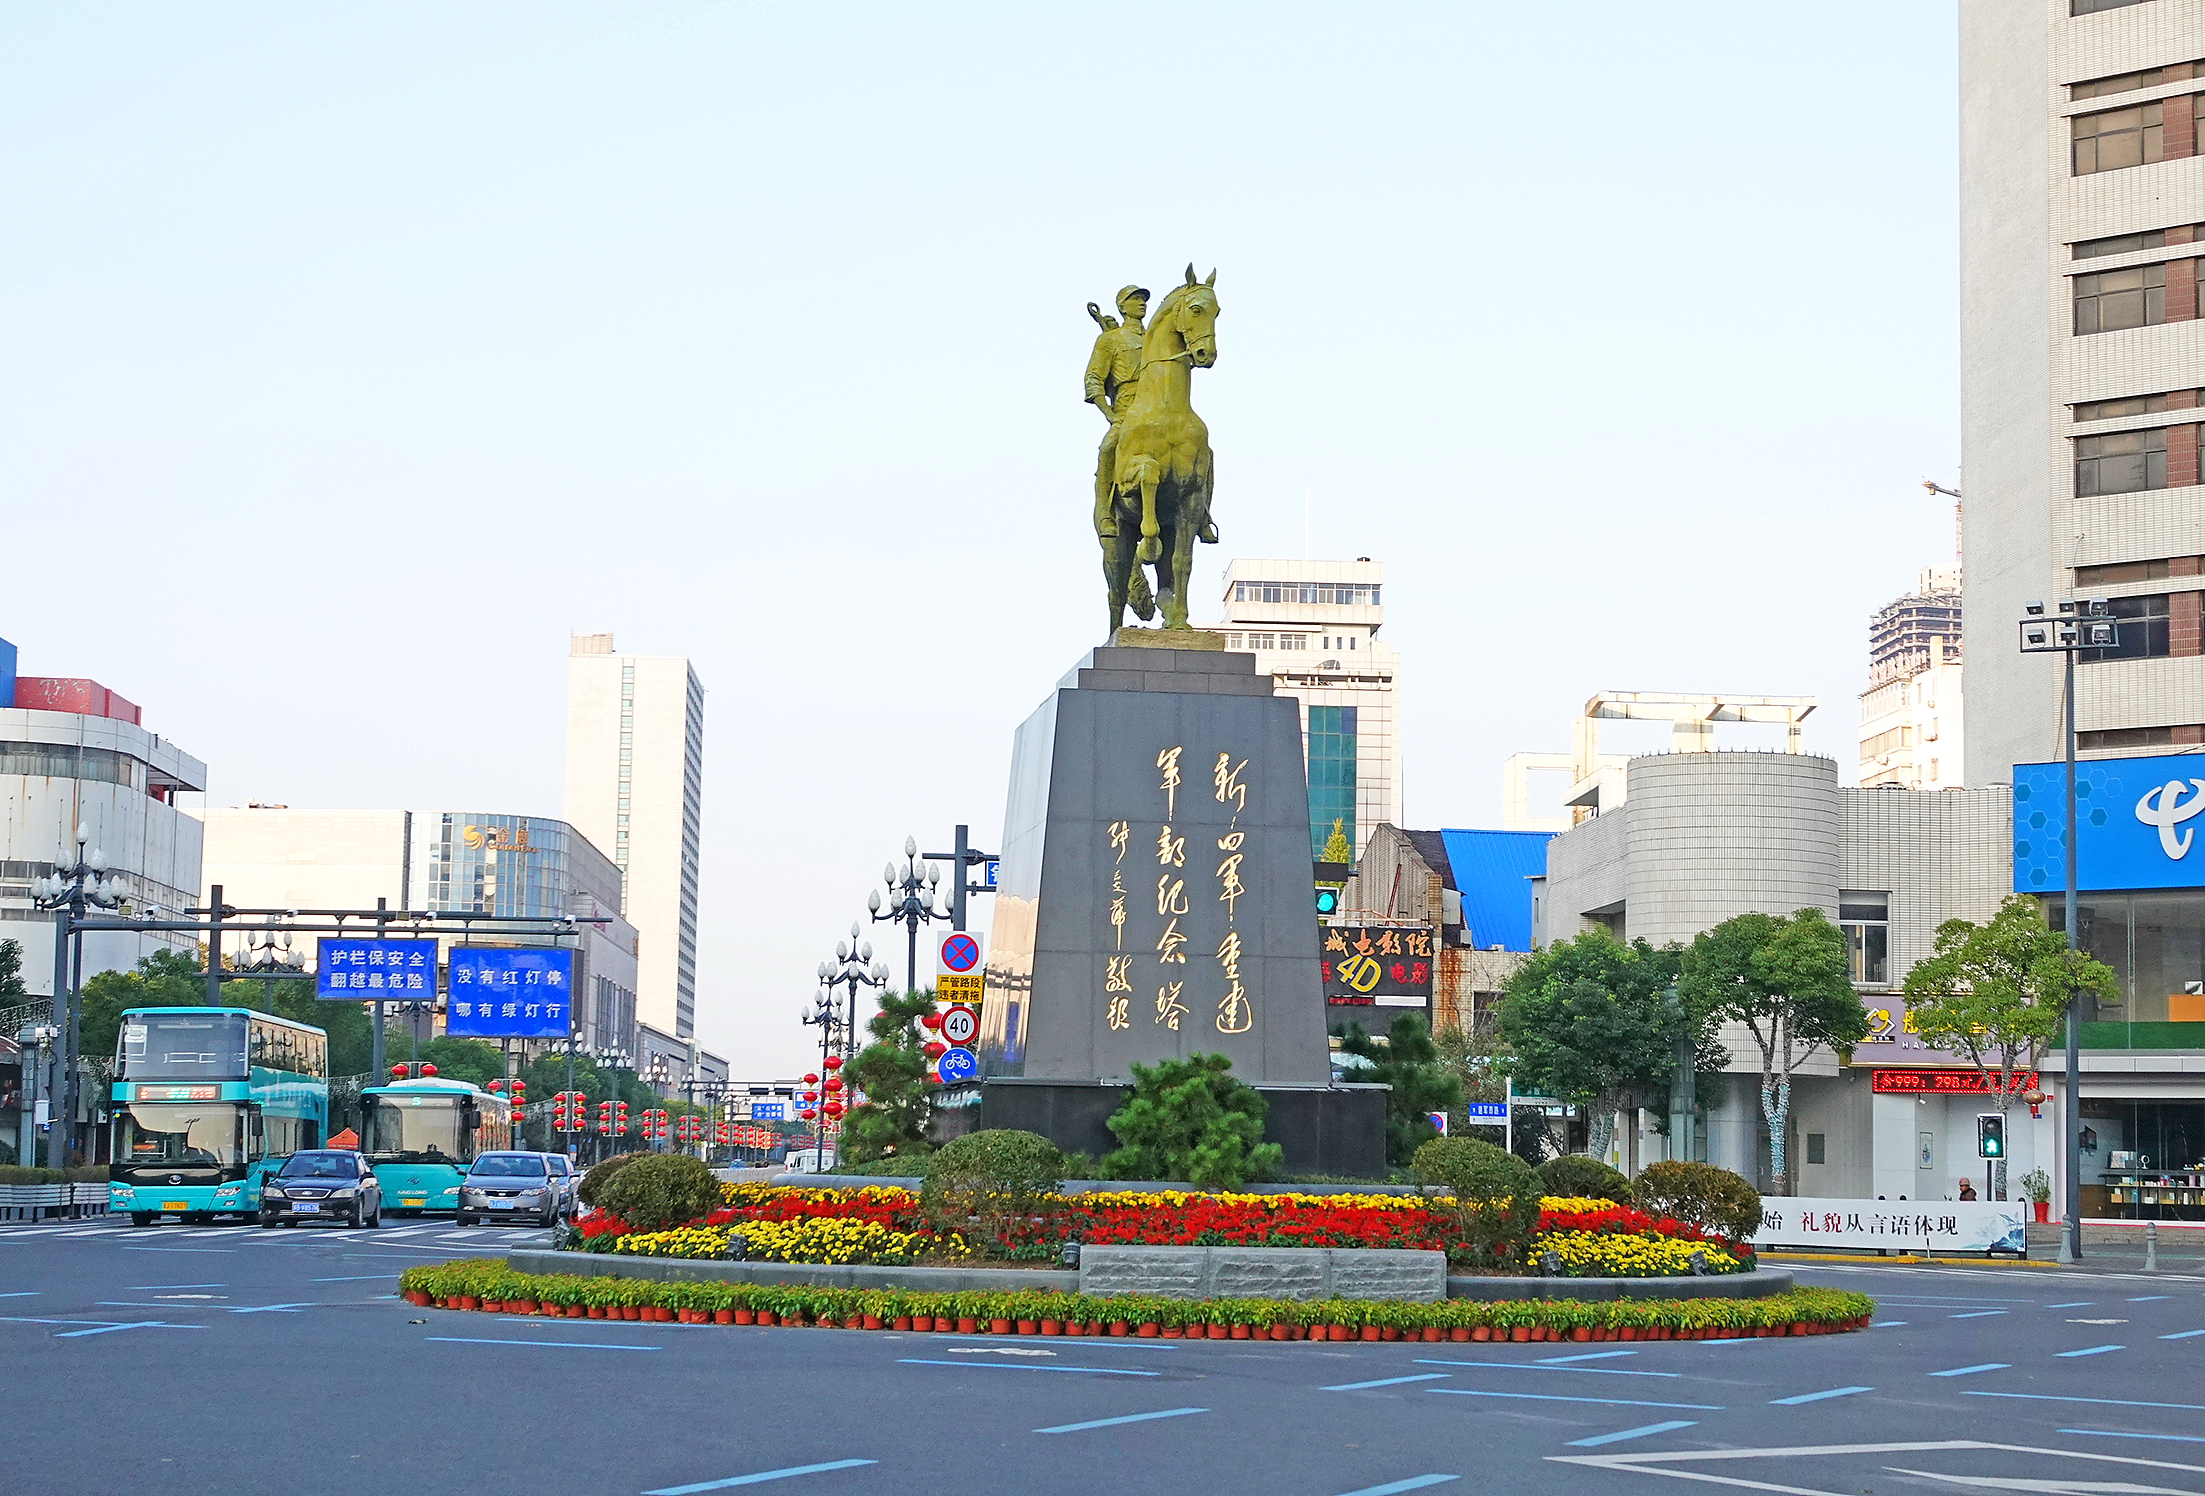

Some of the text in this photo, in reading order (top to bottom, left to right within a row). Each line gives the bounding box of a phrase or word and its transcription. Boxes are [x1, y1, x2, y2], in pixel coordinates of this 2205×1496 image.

[331, 950, 425, 967] 护栏保安全
[330, 972, 424, 989] 翻越最危险
[457, 969, 562, 985] 没有红灯停
[1336, 953, 1382, 993] 4D
[1390, 962, 1429, 984] 电影
[940, 976, 980, 989] 严管路段
[939, 989, 980, 1002] 违者清拖
[456, 1002, 561, 1018] 哪有绿灯行
[950, 1017, 969, 1034] 40
[1800, 1211, 1959, 1236] 礼貌从言语体现
